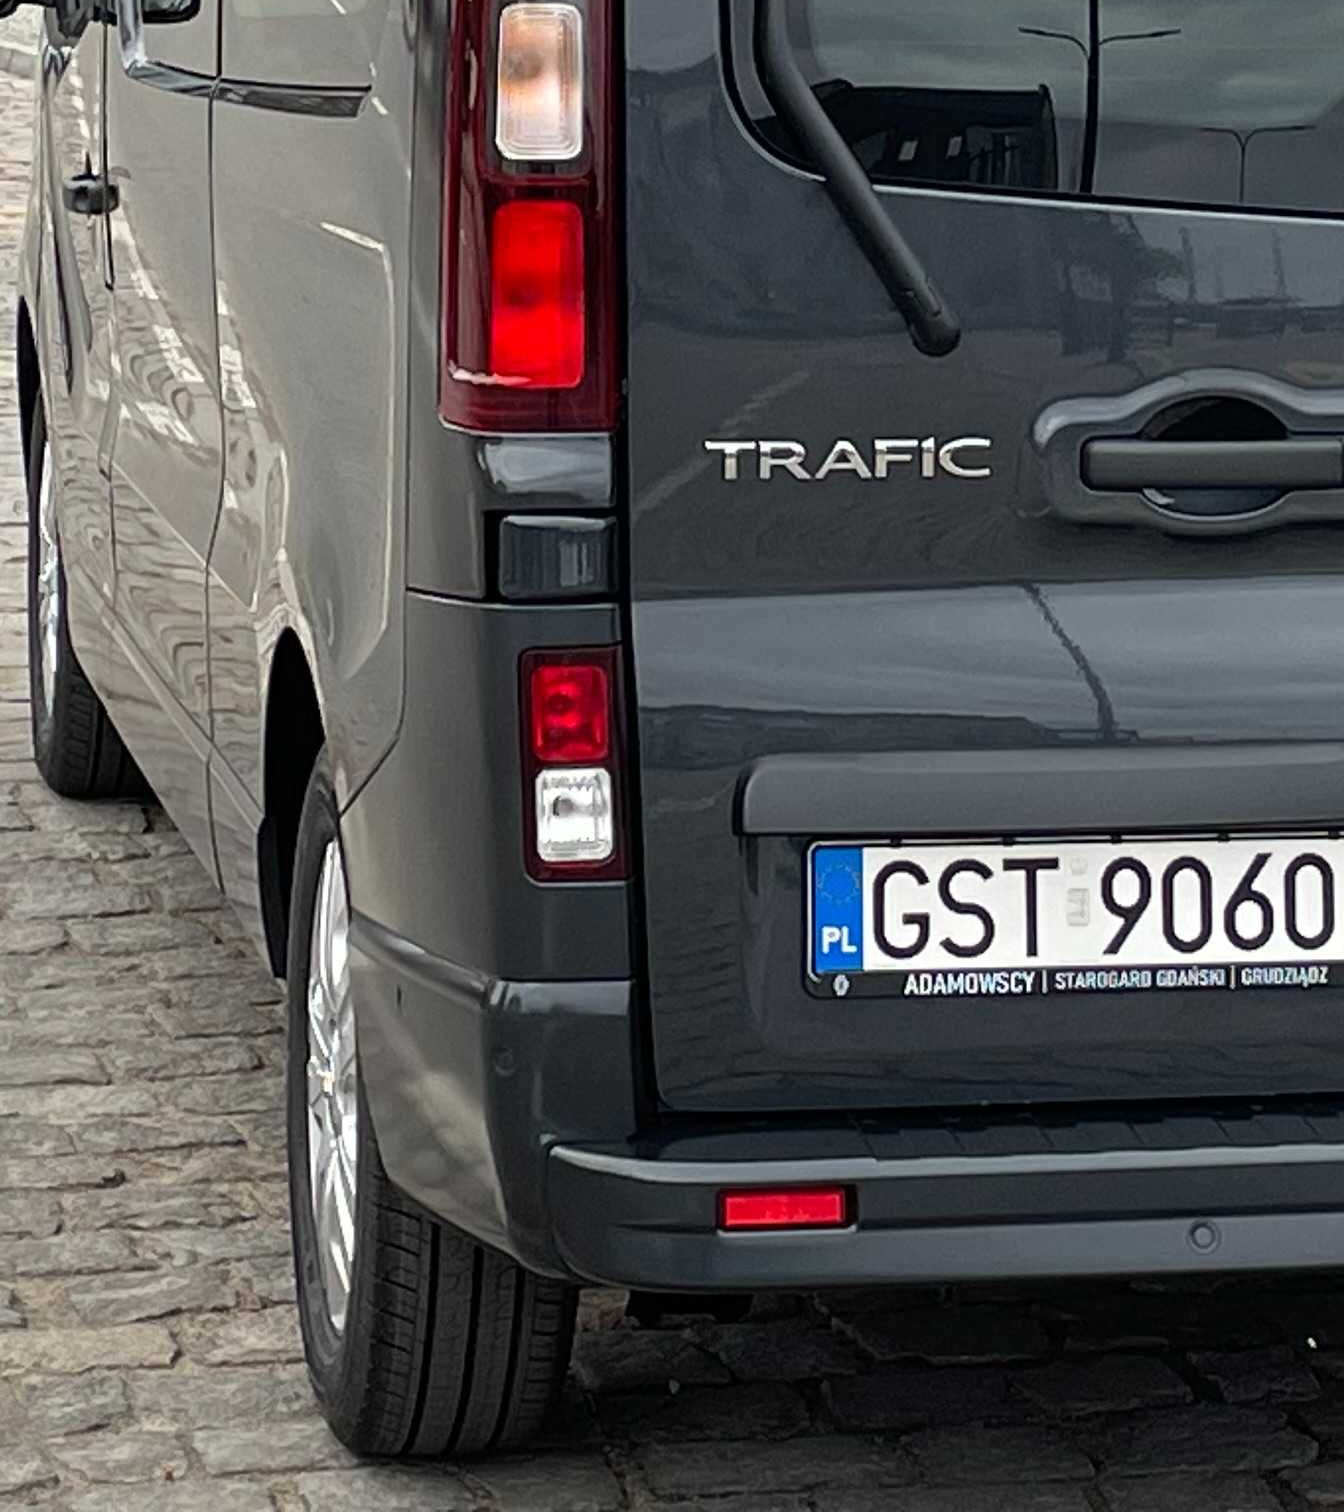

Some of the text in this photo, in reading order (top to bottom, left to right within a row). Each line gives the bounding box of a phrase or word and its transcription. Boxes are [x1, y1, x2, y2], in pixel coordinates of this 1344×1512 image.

[704, 437, 992, 480] TRAFIC
[872, 858, 1059, 959] GST
[822, 925, 857, 953] PL
[904, 965, 1329, 995] ADAMOWSCY STAROGARD GDAŃSKI GRUDZIĄDZ
